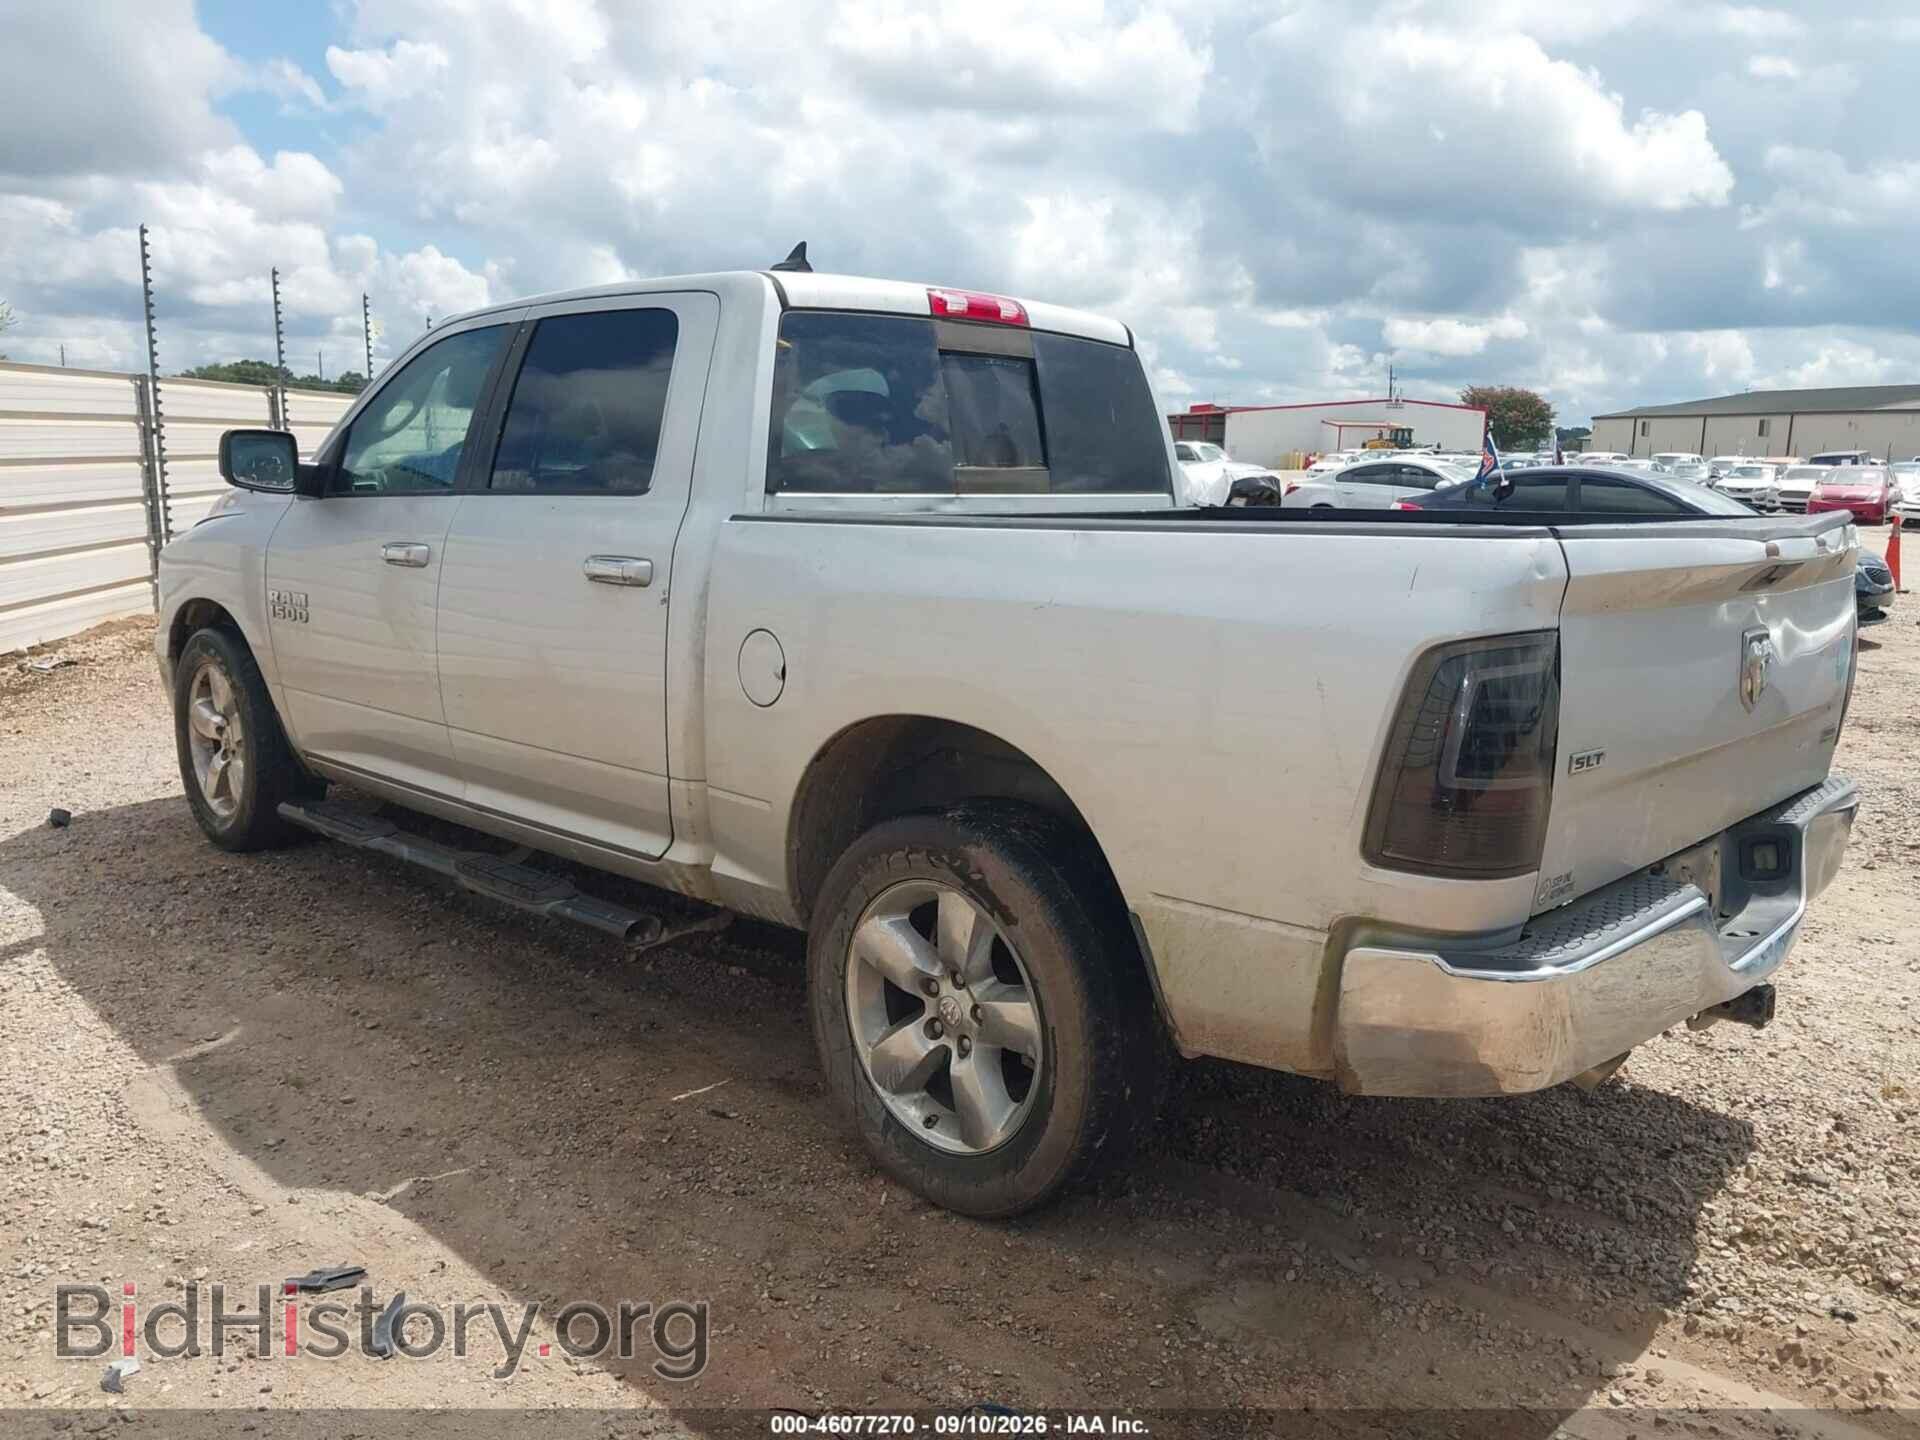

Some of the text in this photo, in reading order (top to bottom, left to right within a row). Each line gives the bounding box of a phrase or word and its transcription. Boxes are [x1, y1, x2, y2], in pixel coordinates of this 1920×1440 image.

[270, 590, 309, 607] RAM
[271, 605, 310, 624] 1500
[1573, 751, 1605, 771] SLT
